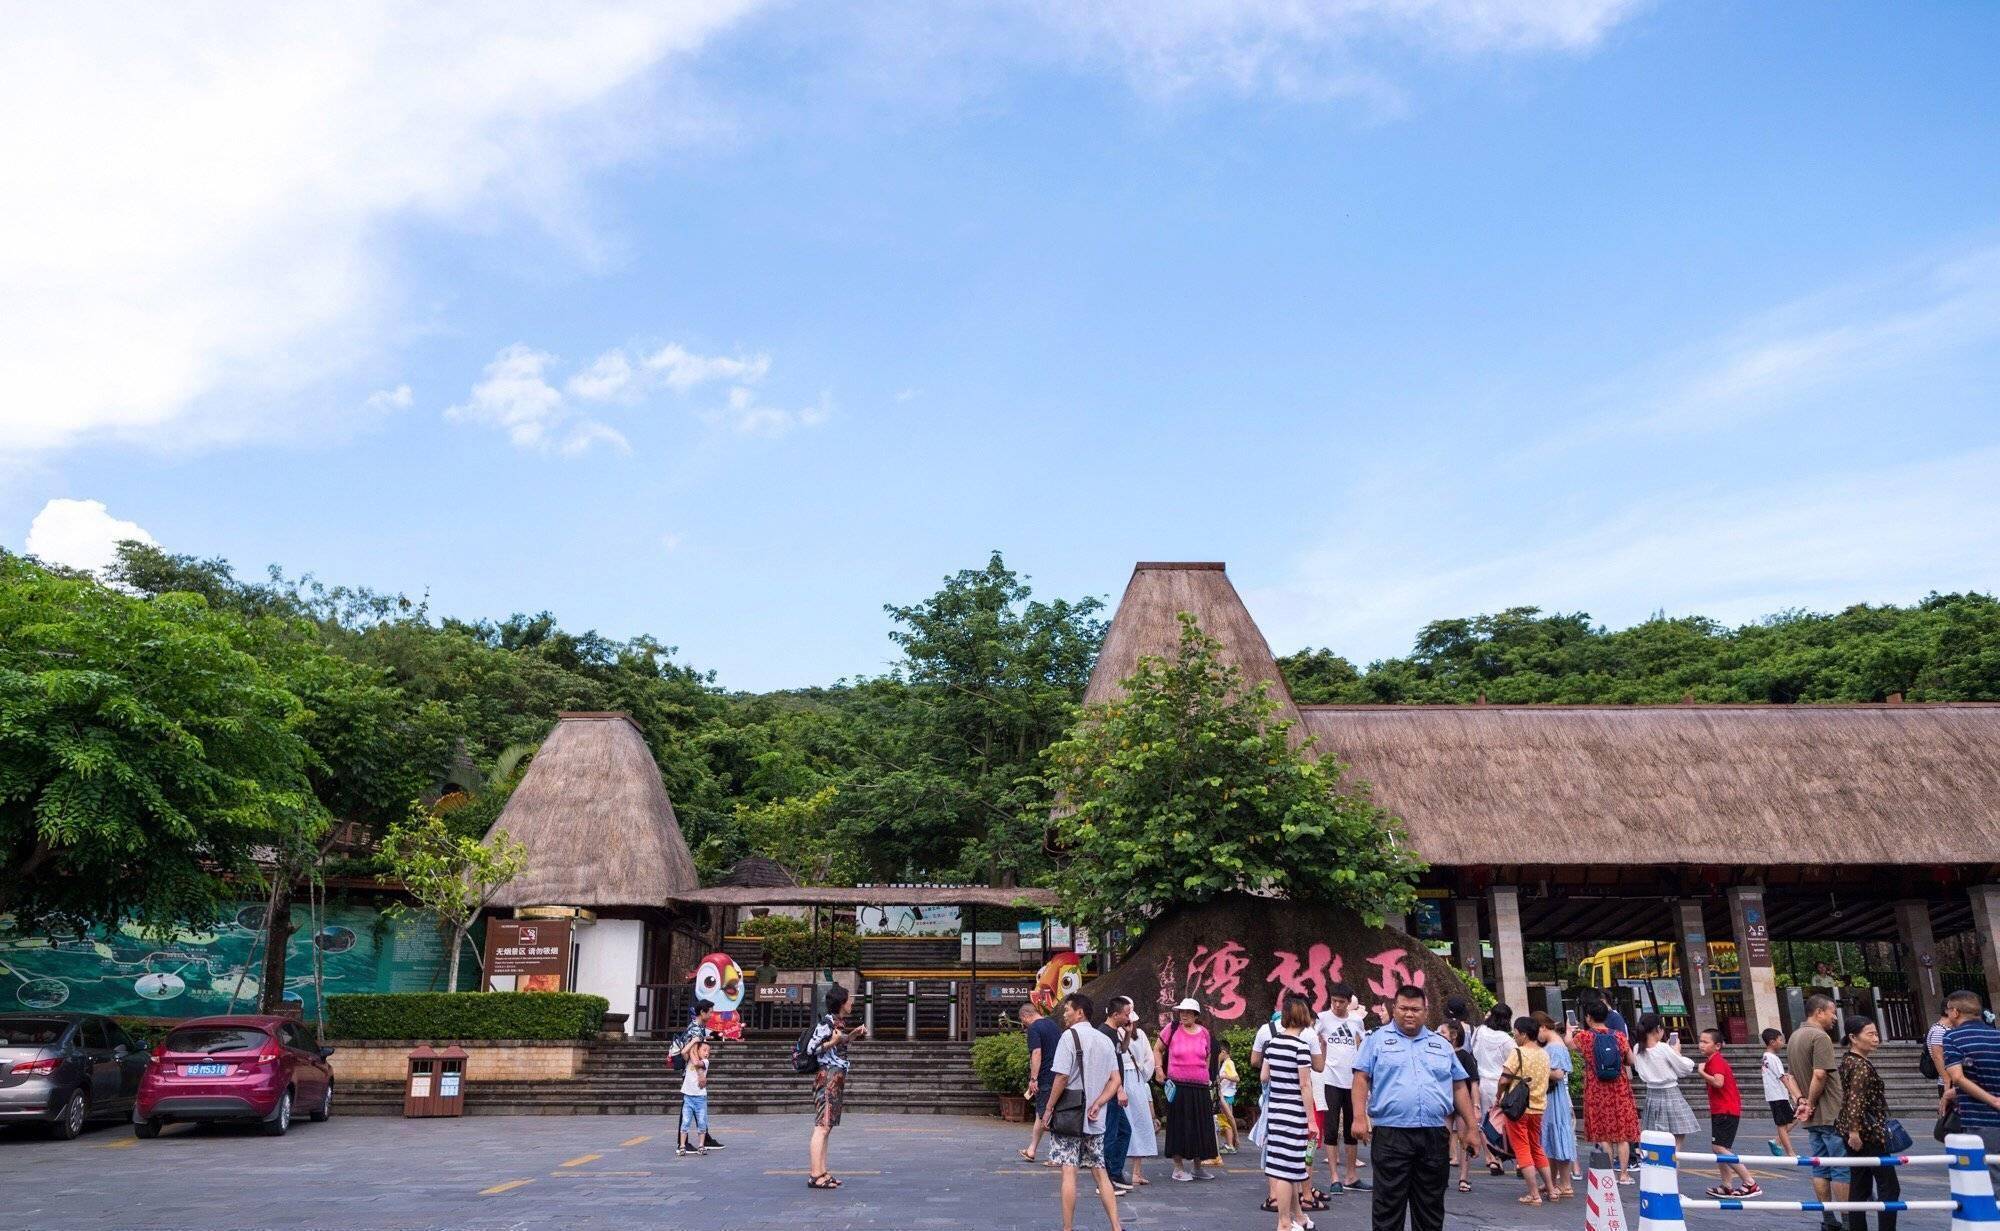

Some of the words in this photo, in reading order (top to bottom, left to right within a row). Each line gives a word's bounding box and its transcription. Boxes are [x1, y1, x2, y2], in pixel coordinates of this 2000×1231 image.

[496, 947, 526, 956] 无烟景区
[528, 947, 558, 955] 请勿吸烟
